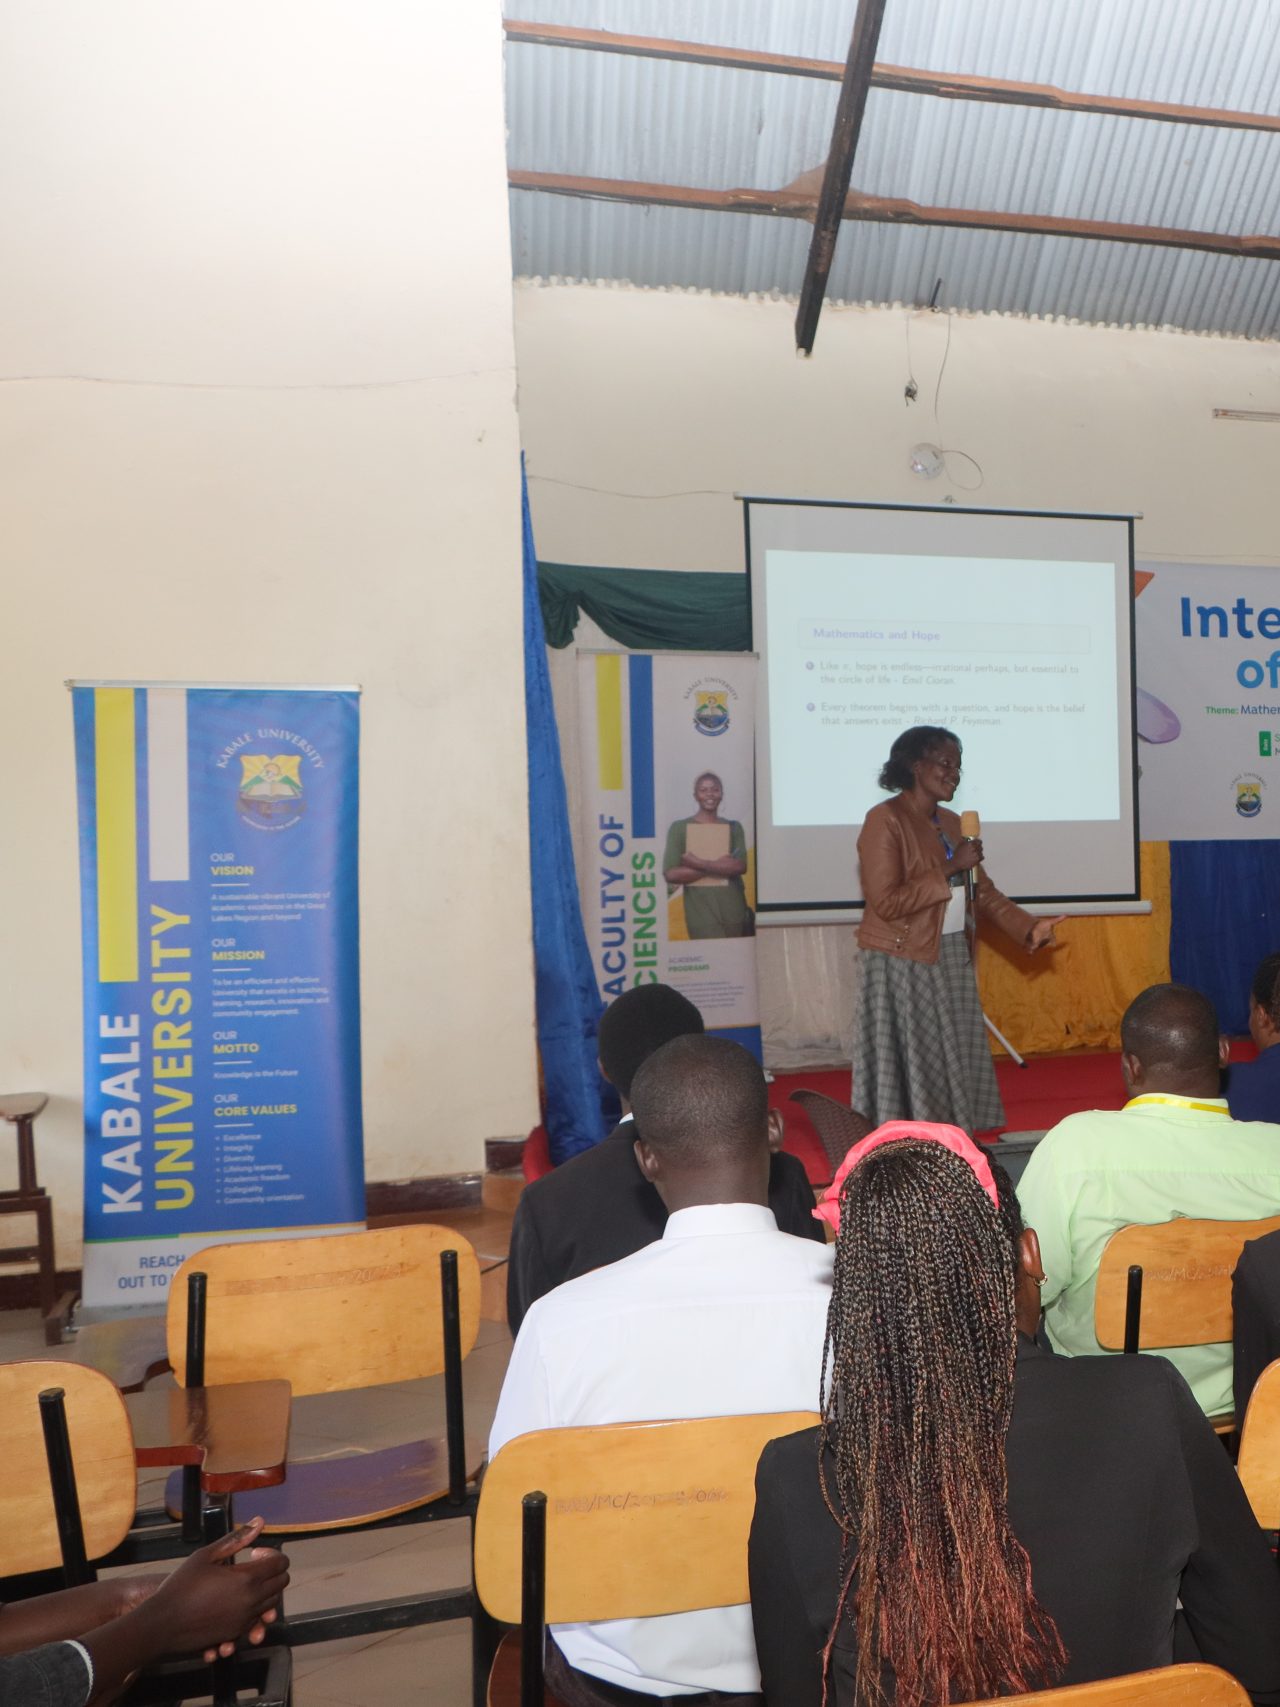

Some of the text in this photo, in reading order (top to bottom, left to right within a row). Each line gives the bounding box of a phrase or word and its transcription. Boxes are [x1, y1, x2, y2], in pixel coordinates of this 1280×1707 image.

[813, 628, 941, 642] Mathematics and Hope
[820, 661, 839, 671] Like
[855, 661, 877, 673] hope
[1014, 664, 1029, 674] but
[1031, 664, 1067, 674] essential
[820, 675, 836, 684] the
[821, 701, 848, 713] Every
[850, 701, 887, 712] theorem
[889, 701, 919, 714] begins
[921, 702, 941, 712] with
[994, 703, 1010, 713] and
[1013, 703, 1035, 714] hope
[1046, 703, 1060, 713] the
[1063, 703, 1086, 713] belief
[1205, 705, 1239, 716] Theme:
[821, 716, 841, 725] that
[216, 728, 326, 770] KABALE UNIVERSITY
[598, 813, 625, 859] OF
[210, 852, 235, 863] OUR
[210, 866, 254, 876] VISION
[631, 850, 658, 989] CIENCES
[211, 938, 236, 948] OUR
[211, 950, 265, 961] MISSION
[213, 1030, 238, 1041] OUR
[213, 1042, 260, 1054] MOTTO
[151, 903, 195, 1211] UNIVERSITY
[213, 1071, 253, 1080] Knowledge
[275, 1068, 299, 1077] Future
[214, 1093, 239, 1104] OUR
[100, 1013, 143, 1215] KABALE
[214, 1103, 298, 1117] CORE VALUES
[223, 1133, 262, 1142] Excellence
[139, 1254, 186, 1269] REACH
[118, 1273, 168, 1289] OUT TO
